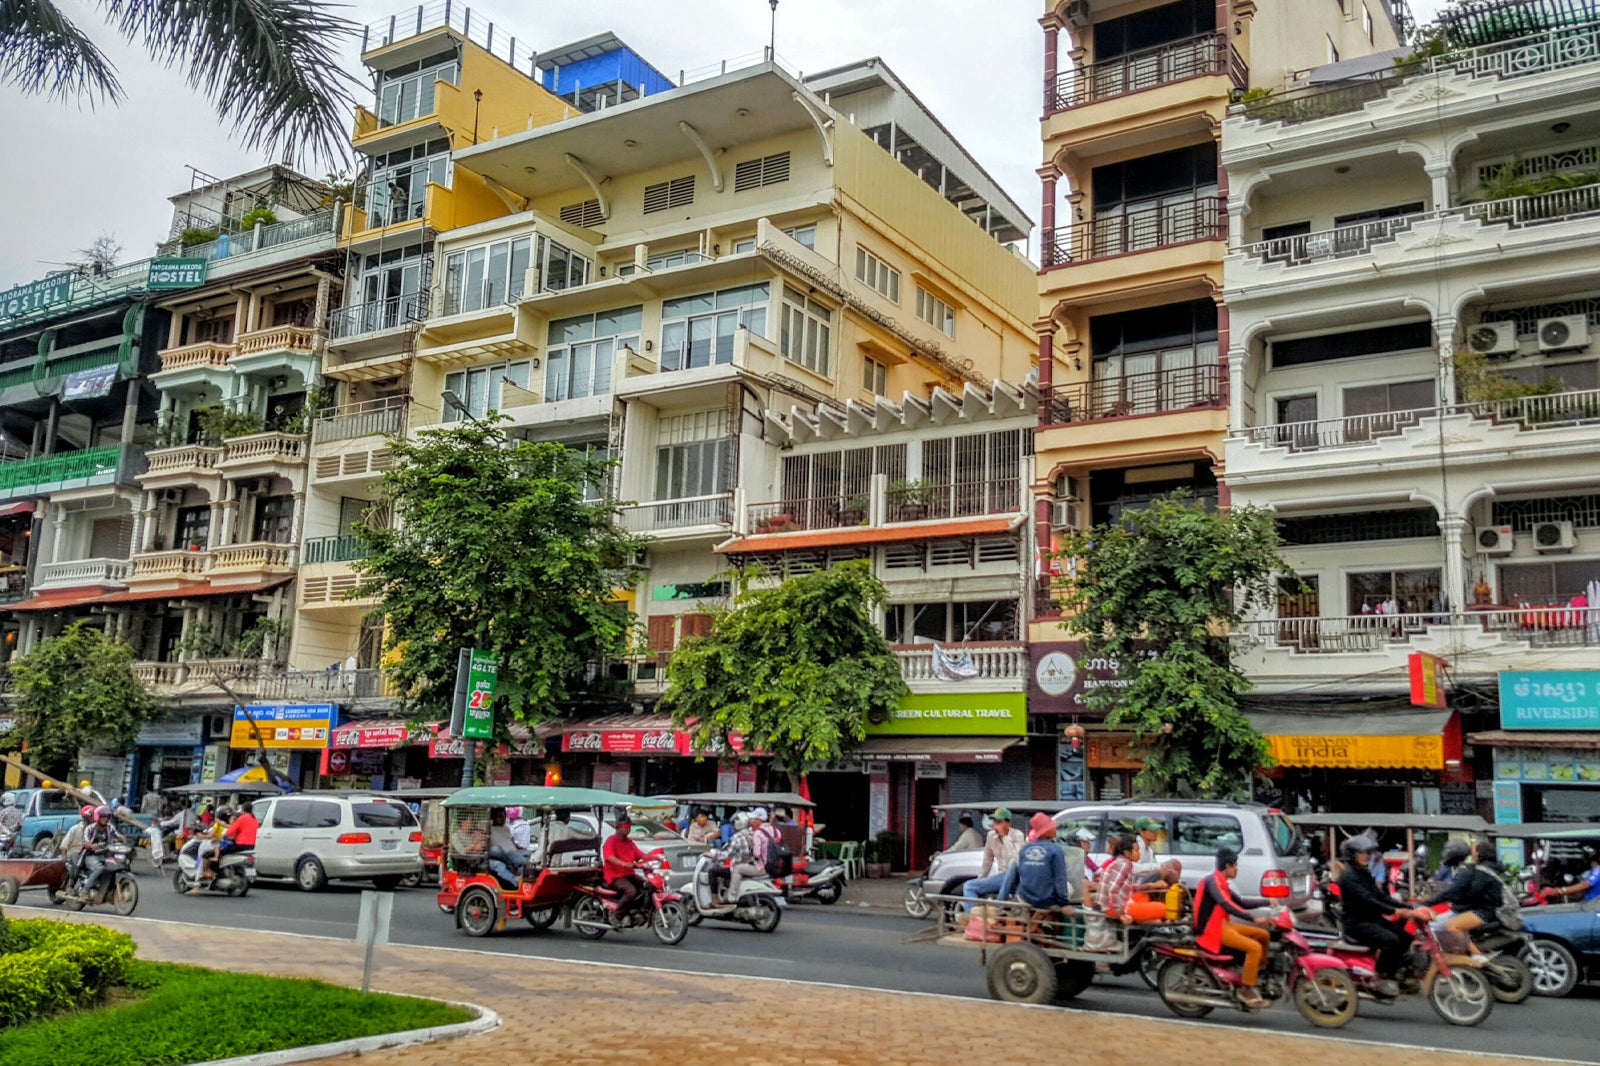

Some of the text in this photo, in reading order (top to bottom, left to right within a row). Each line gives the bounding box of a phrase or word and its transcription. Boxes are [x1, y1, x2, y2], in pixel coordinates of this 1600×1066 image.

[150, 271, 201, 283] HOSTEL
[34, 275, 67, 292] MEKONG
[472, 663, 497, 674] 4G LTE
[923, 709, 972, 718] CULTURAL
[975, 709, 1012, 718] TRAVEL
[1516, 706, 1598, 719] RIVERSIDE
